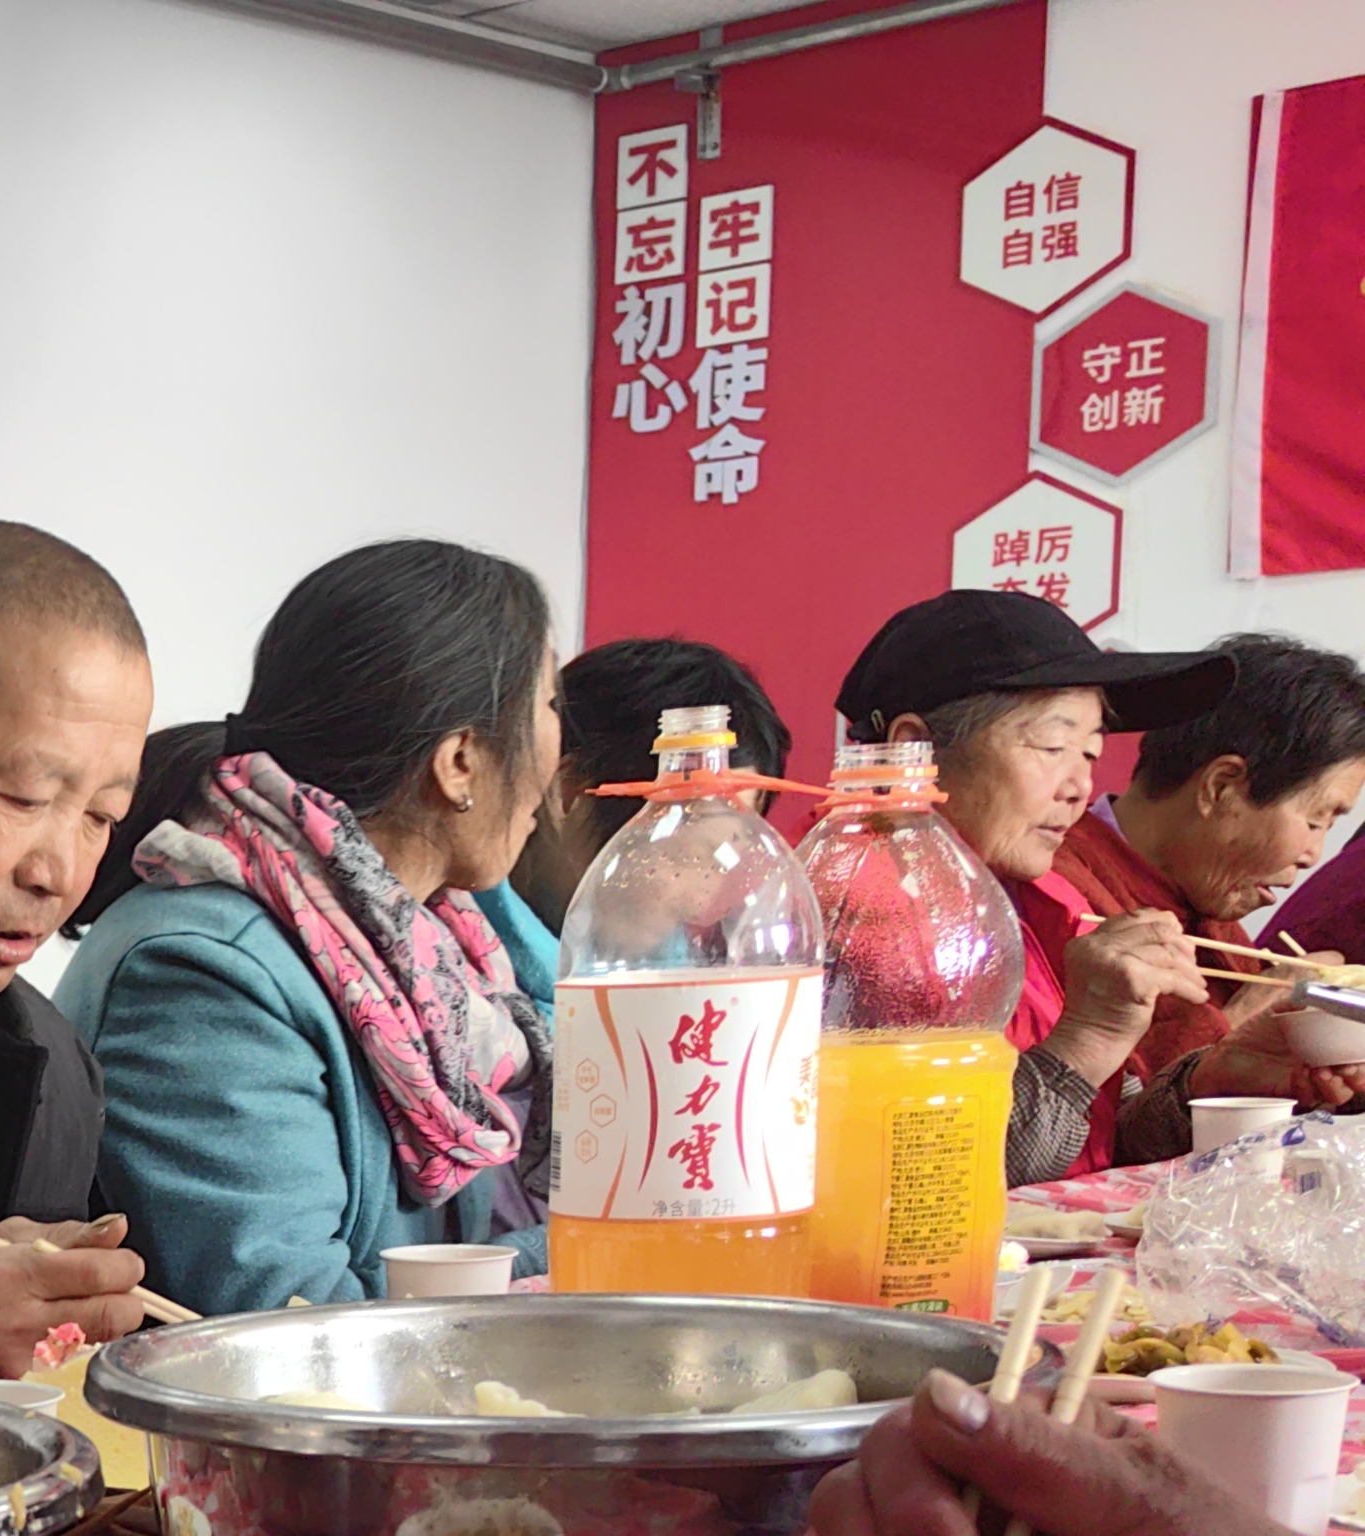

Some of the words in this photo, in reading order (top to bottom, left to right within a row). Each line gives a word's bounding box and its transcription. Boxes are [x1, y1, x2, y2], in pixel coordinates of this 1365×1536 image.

[1003, 172, 1083, 222] 自信
[1001, 222, 1080, 269] 自强
[611, 137, 688, 434] 不忘初心
[689, 200, 768, 504] 牢记使命
[1081, 337, 1166, 384] 守正
[1079, 385, 1164, 434] 创新
[992, 525, 1072, 567] 踔厉
